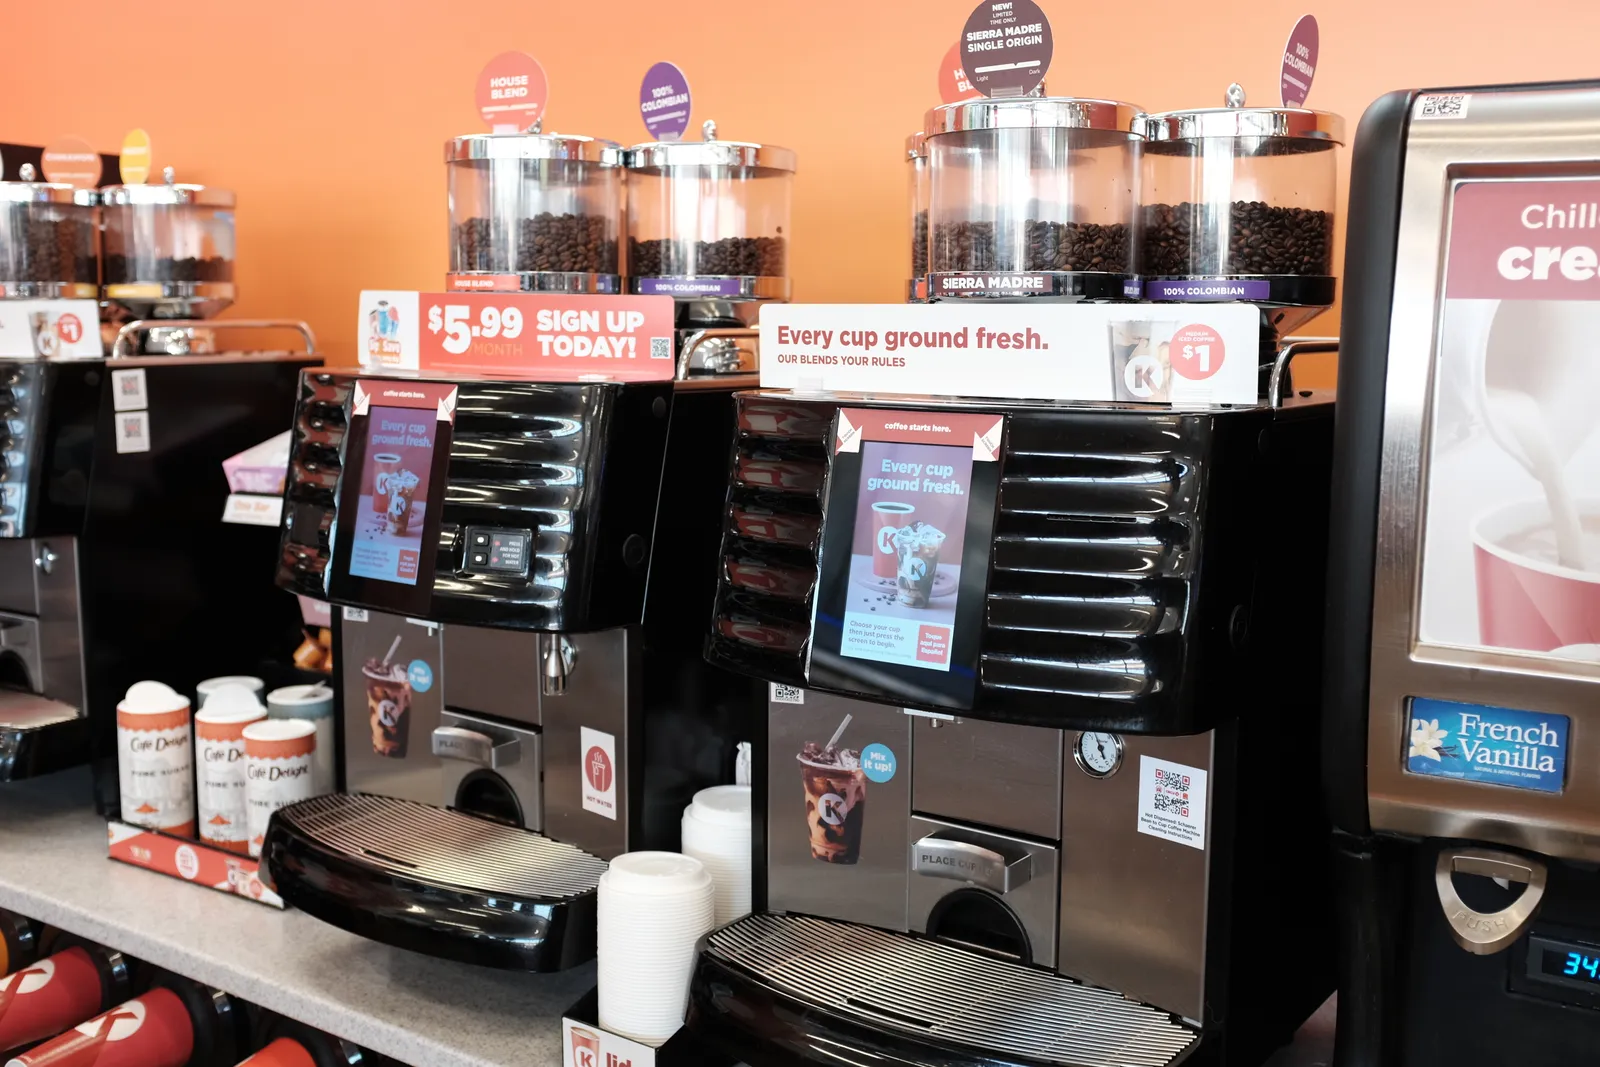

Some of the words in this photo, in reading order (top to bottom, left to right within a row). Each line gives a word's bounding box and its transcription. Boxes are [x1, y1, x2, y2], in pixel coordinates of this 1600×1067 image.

[992, 2, 1013, 12] NEW!
[993, 10, 1013, 18] LIMITED
[966, 28, 1004, 42] SIERRA
[1004, 23, 1043, 37] MADRE
[967, 40, 1004, 53] SINGLE
[1006, 34, 1043, 48] ORIGIN
[1295, 42, 1310, 60] 100%
[1284, 51, 1314, 78] COLOMBIAN
[490, 74, 529, 88] HOUSE
[976, 75, 989, 83] Light
[491, 87, 528, 100] BLEND
[651, 84, 674, 99] 100%
[641, 92, 689, 113] COLOMBIAN
[1521, 203, 1600, 229] Chill
[1497, 245, 1600, 281] cre
[471, 280, 494, 288] BLEND
[655, 283, 673, 292] 100%
[673, 284, 721, 292] COLOMBIAN
[942, 277, 986, 290] SIERRA
[987, 276, 1044, 289] MADRE
[1163, 287, 1185, 296] 100%
[1186, 286, 1245, 296] COLOMBIAN
[428, 304, 524, 354] $5.99
[536, 309, 603, 333] SIGN
[606, 310, 645, 334] UP
[777, 325, 833, 350] Every
[839, 328, 878, 351] cup
[885, 326, 968, 352] ground
[975, 326, 1049, 350] fresh.
[536, 335, 637, 359] TODAY!
[777, 354, 798, 364] OUR
[800, 354, 838, 365] BLENDS
[841, 355, 869, 367] YOUR
[871, 356, 906, 368] RULES
[1182, 343, 1211, 373] $1
[381, 419, 407, 433] Every
[408, 423, 427, 436] cup
[884, 421, 908, 431] coffee
[909, 423, 931, 432] starts
[932, 424, 952, 433] here.
[371, 433, 405, 447] ground
[405, 434, 433, 448] fresh.
[881, 458, 923, 477] Every
[925, 463, 954, 479] cup
[867, 477, 920, 492] ground
[922, 478, 964, 496] fresh.
[848, 628, 864, 636] then
[862, 629, 876, 638] just
[876, 632, 893, 641] press
[893, 634, 905, 642] the
[849, 620, 873, 630] Choose
[873, 623, 888, 631] your
[888, 626, 901, 634] cup
[848, 636, 868, 646] screen
[868, 638, 876, 646] to
[876, 639, 896, 649] begin.
[1457, 712, 1560, 748] French
[130, 736, 153, 753] Café
[203, 747, 225, 763] Café
[869, 751, 887, 762] Mix
[1457, 737, 1557, 774] Vanilla
[247, 764, 266, 780] Café
[863, 758, 873, 769] it
[874, 761, 893, 773] up!
[1140, 816, 1153, 824] Bean
[1157, 821, 1167, 829] Cup
[1167, 823, 1183, 832] Coffee
[1182, 827, 1201, 838] Machine
[1147, 824, 1168, 835] Cleaning
[1167, 829, 1193, 842] Instructions
[922, 854, 957, 867] PLACE
[1452, 910, 1510, 933] PUSH
[580, 1051, 593, 1067] K
